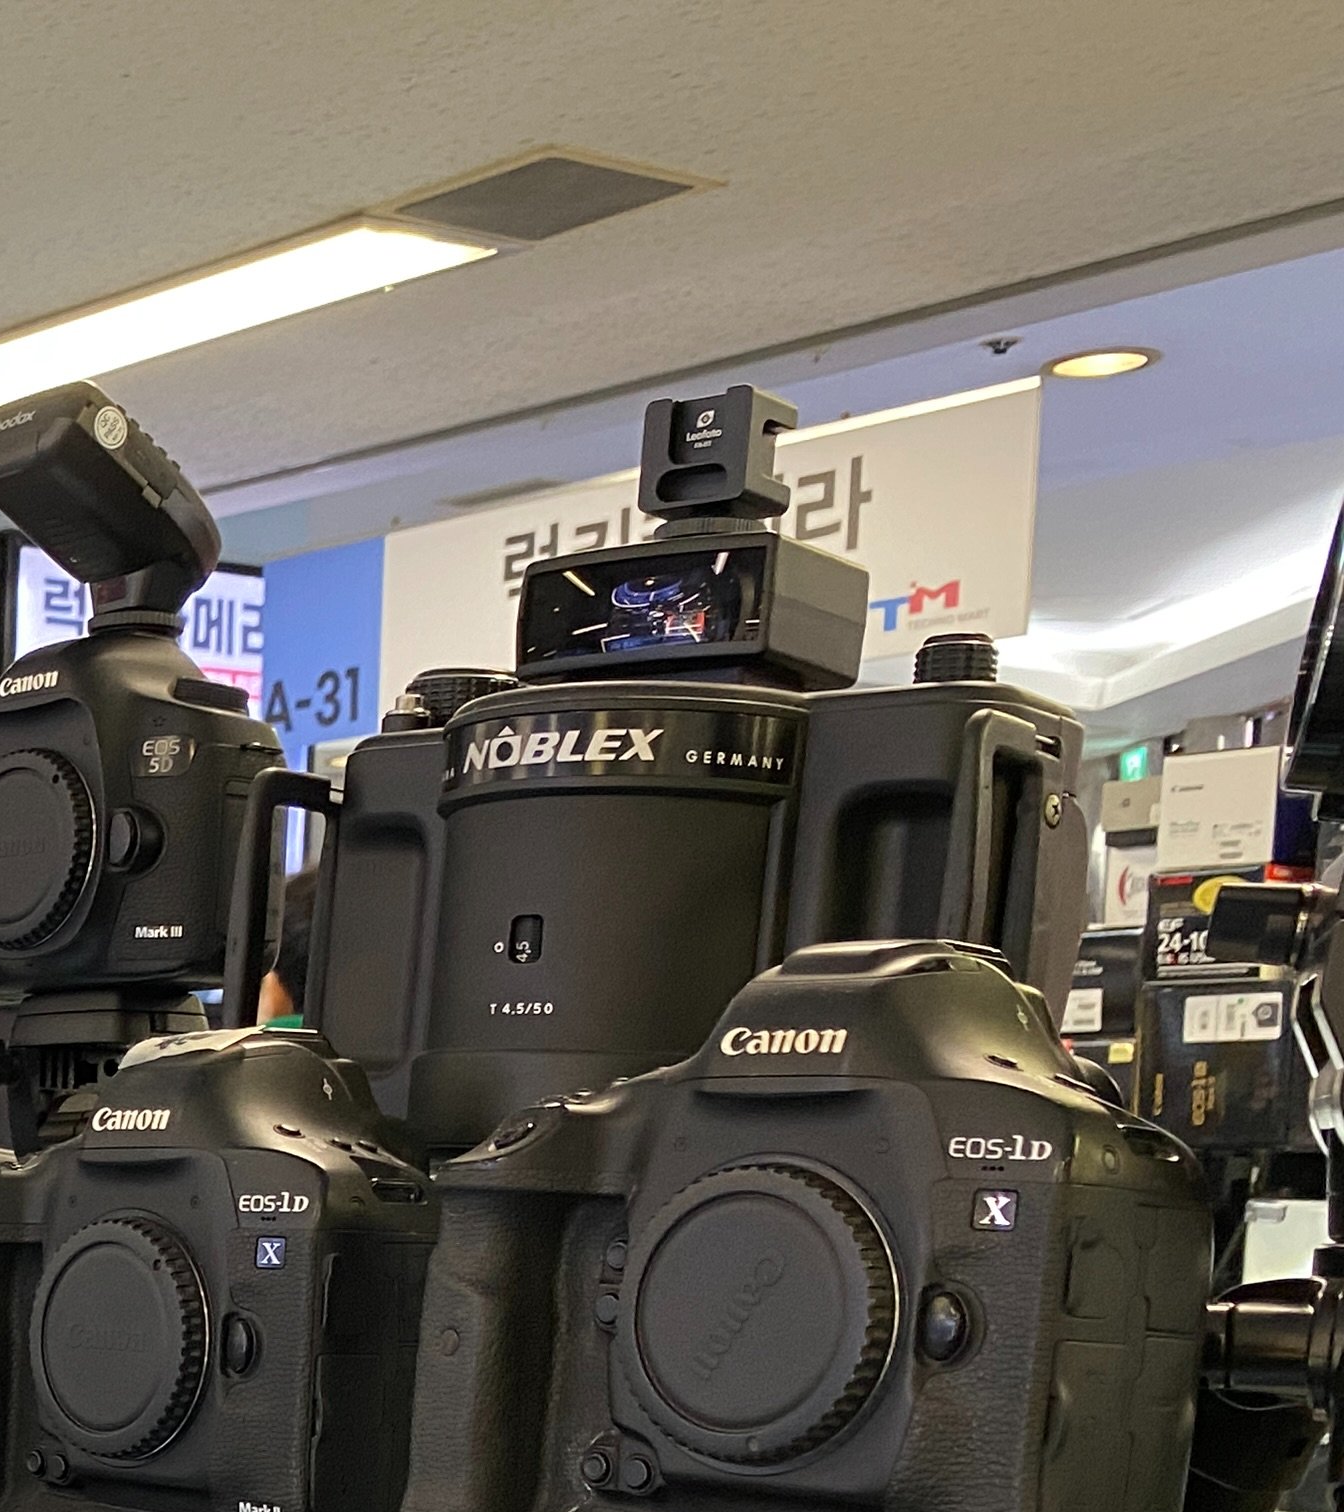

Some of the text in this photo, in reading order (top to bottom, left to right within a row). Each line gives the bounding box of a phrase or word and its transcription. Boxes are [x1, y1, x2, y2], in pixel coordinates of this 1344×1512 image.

[264, 666, 360, 732] A-31
[142, 739, 180, 756] EOS
[148, 757, 173, 773] 5D
[685, 749, 785, 771] GERMANY
[134, 925, 183, 939] Mark III
[489, 1002, 554, 1015] T 4.5/50
[719, 1026, 847, 1057] Canon
[92, 1106, 170, 1133] Canon
[948, 1135, 1052, 1162] EOS-1D
[238, 1192, 309, 1214] EOS-1D
[979, 1196, 1012, 1227] X
[260, 1241, 283, 1266] X
